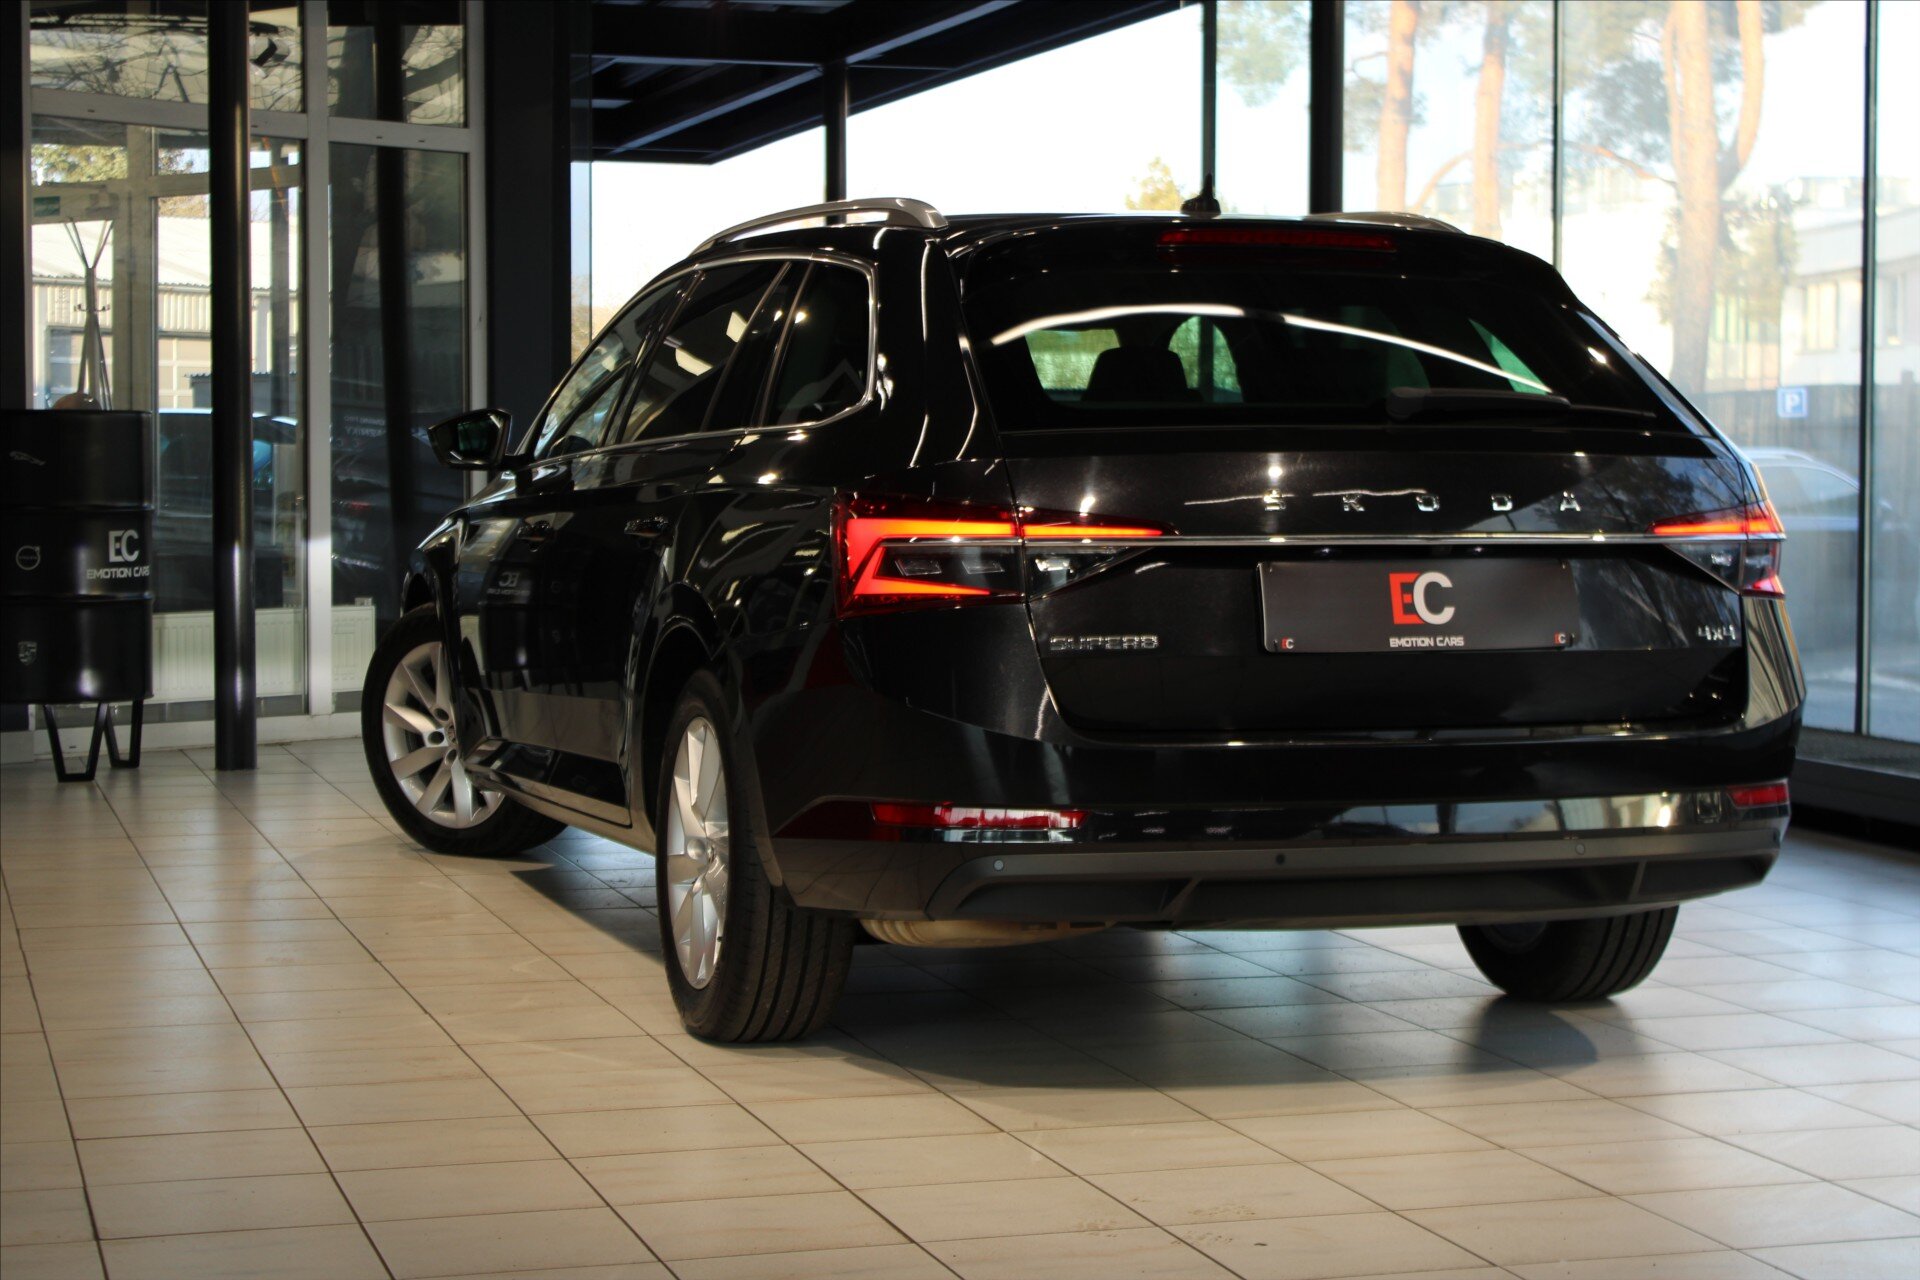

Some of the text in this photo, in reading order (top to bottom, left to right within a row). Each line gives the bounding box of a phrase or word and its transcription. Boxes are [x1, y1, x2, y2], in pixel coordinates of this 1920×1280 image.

[108, 529, 139, 563] EC
[86, 566, 150, 580] EMOTION CARS
[1389, 571, 1455, 625] EC
[1050, 635, 1158, 650] SUPERB
[1389, 635, 1465, 648] EMOTION CARS
